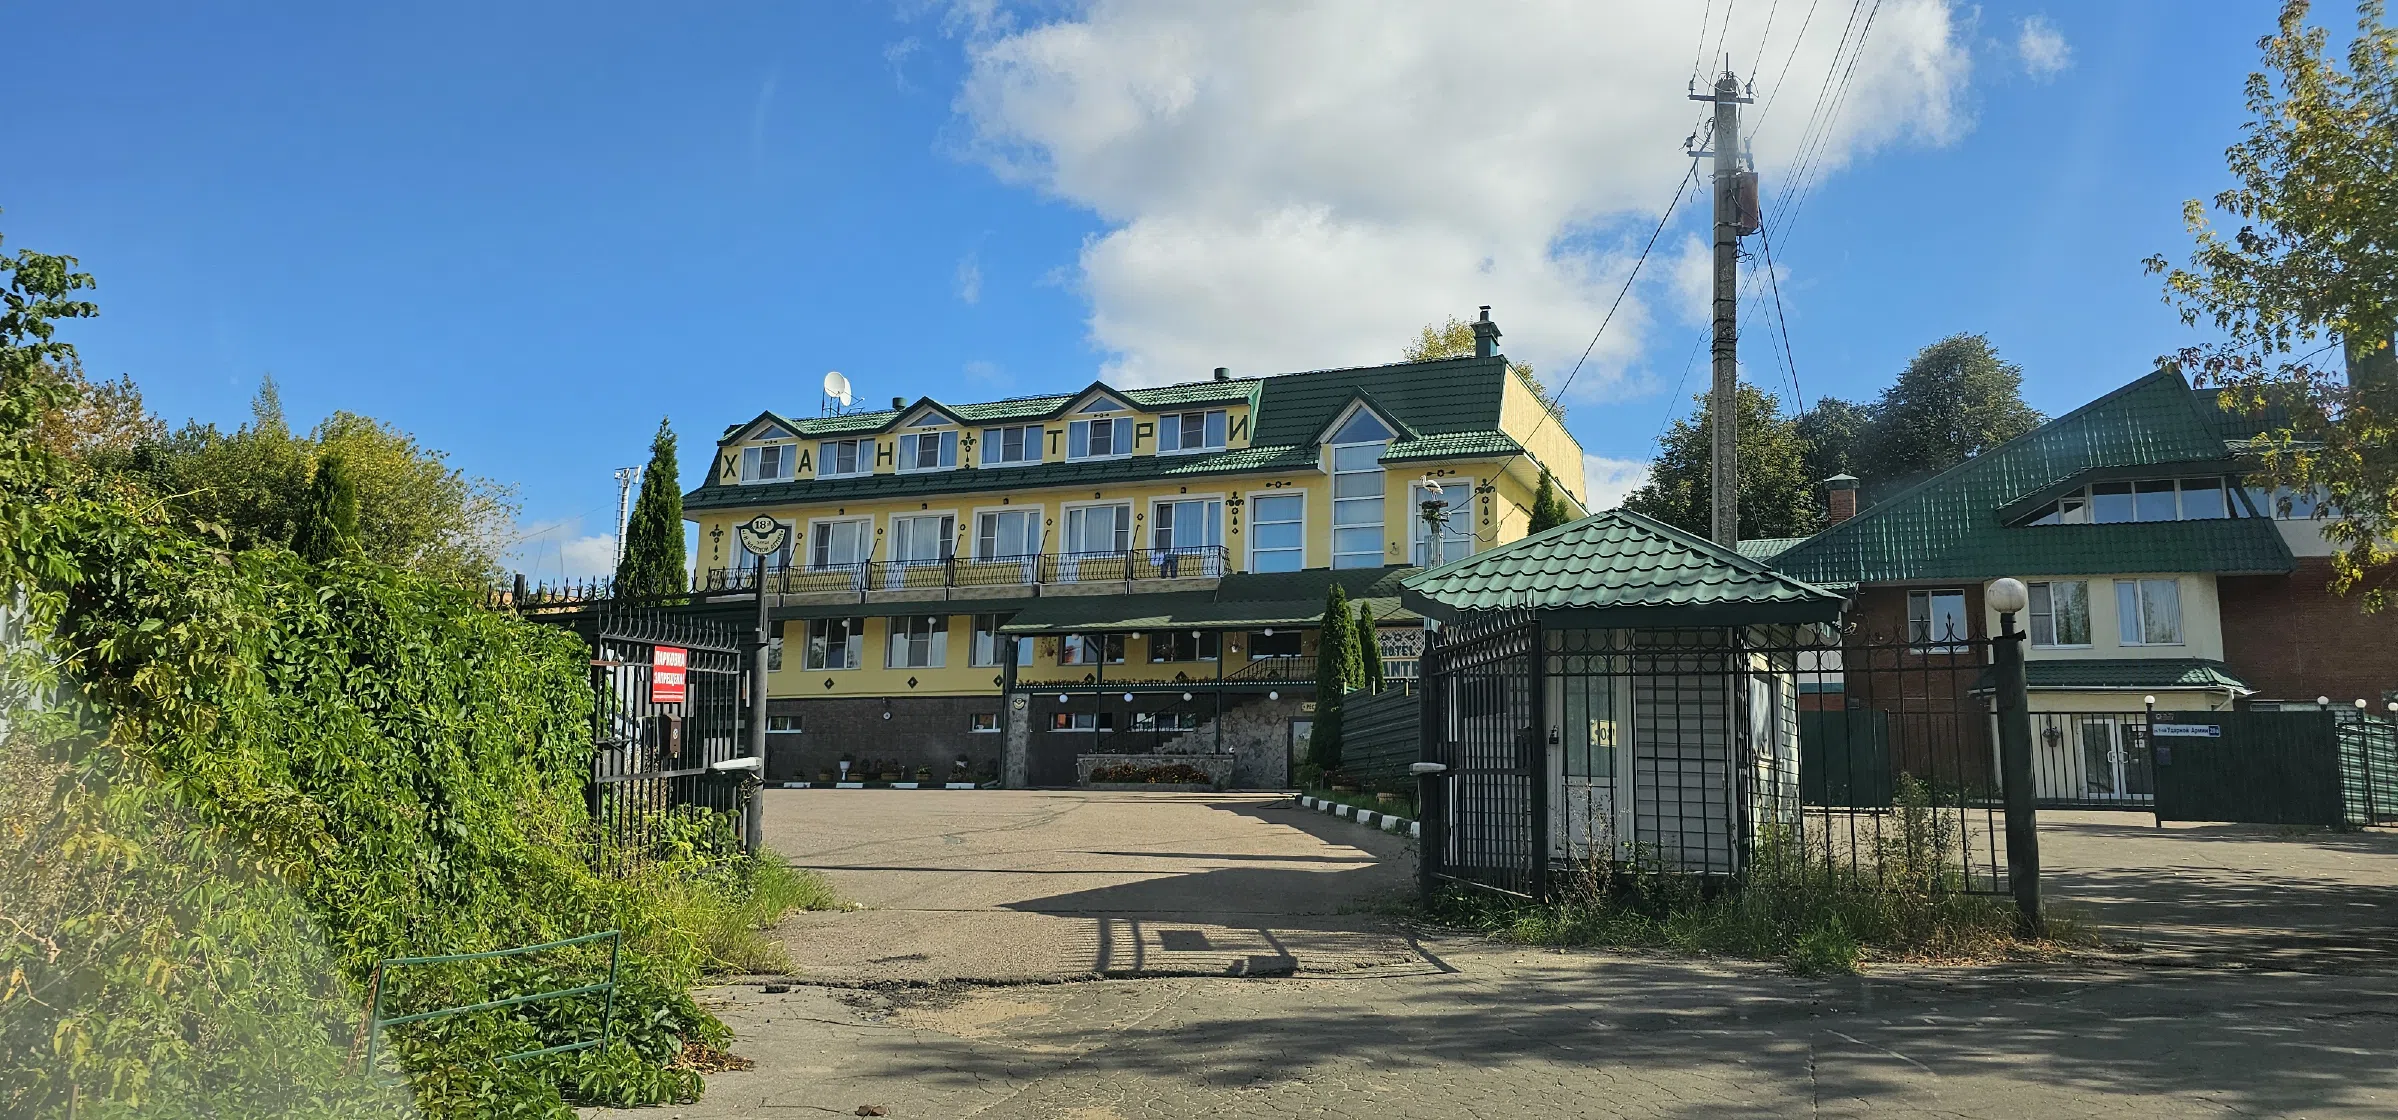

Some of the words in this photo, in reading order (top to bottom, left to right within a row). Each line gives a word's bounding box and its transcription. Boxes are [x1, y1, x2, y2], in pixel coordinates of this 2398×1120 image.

[1382, 645, 1416, 656] HOTEL
[655, 651, 685, 667] ПАРКОВКА
[1383, 661, 1420, 677] ANTR
